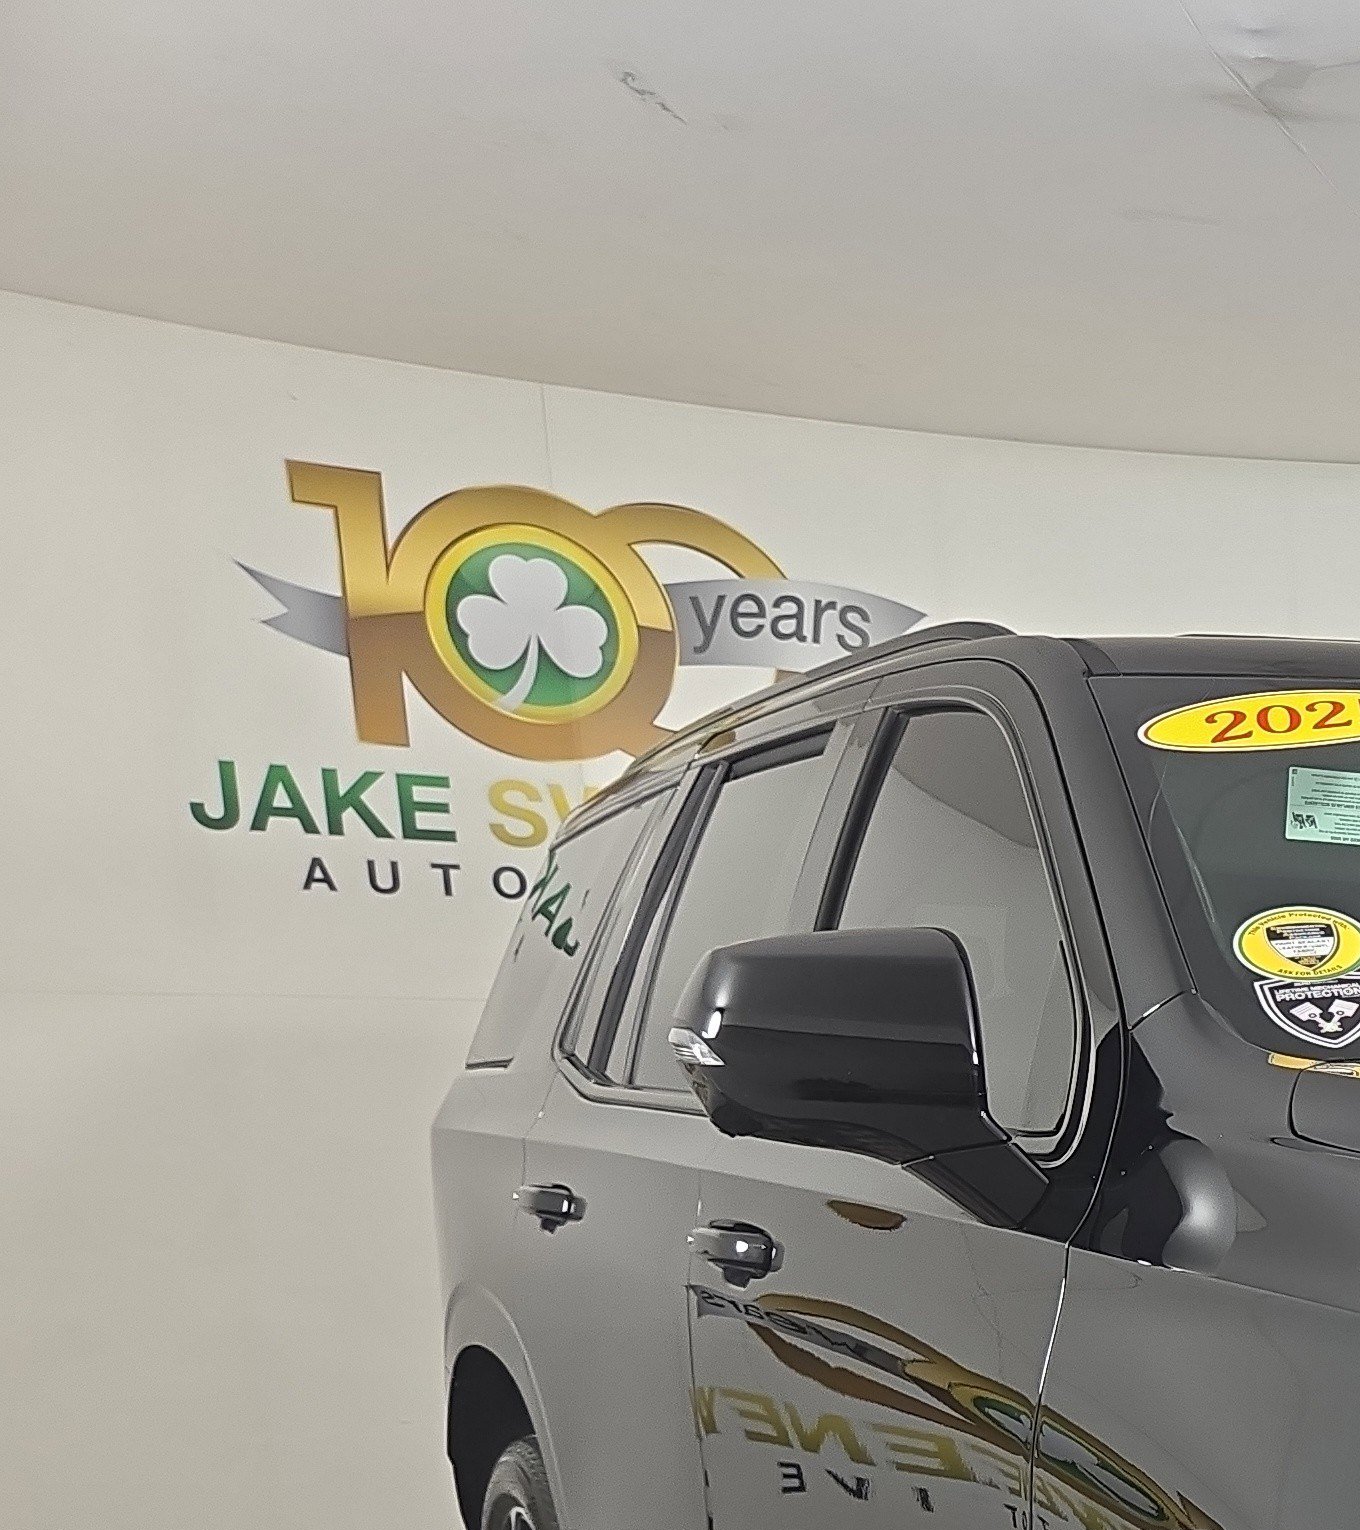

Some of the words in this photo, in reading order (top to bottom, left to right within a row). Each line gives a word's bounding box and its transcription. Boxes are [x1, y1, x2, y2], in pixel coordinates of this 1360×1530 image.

[689, 588, 873, 656] years
[189, 759, 458, 843] JAKE
[1289, 912, 1332, 922] Protected
